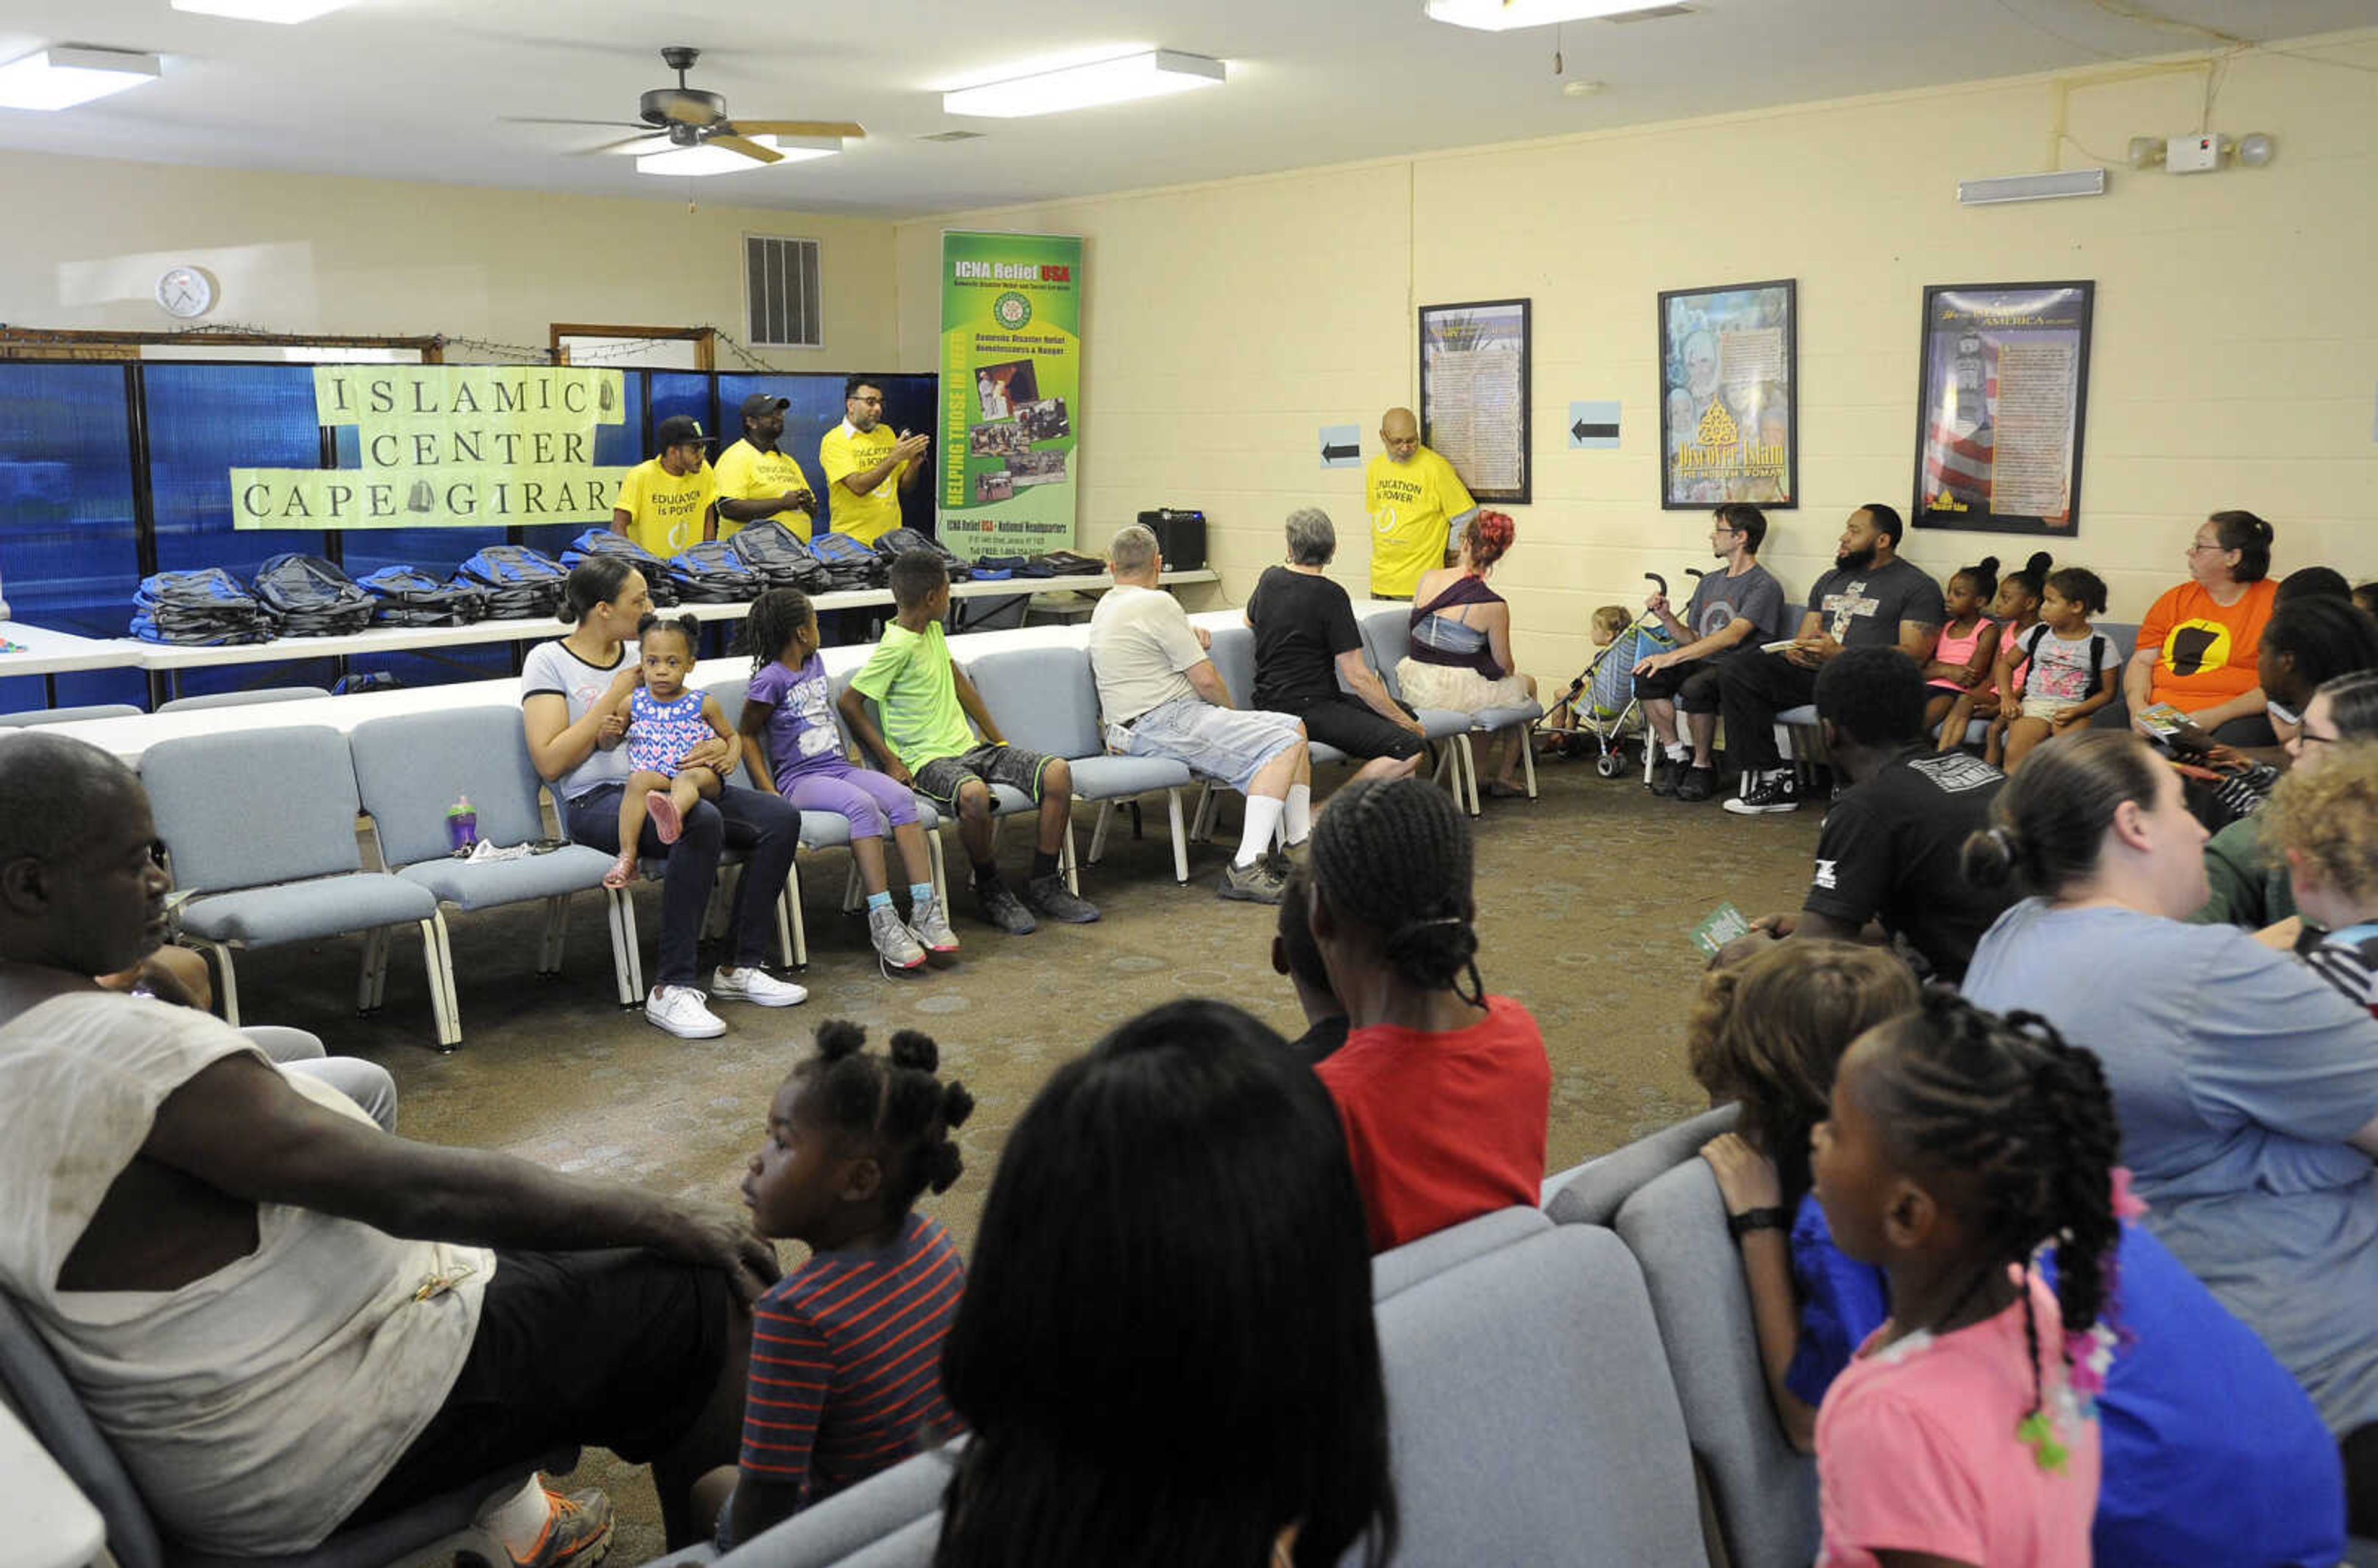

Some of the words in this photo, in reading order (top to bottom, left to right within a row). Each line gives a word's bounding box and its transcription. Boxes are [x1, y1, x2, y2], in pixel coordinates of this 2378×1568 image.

[955, 261, 991, 278] ICNA
[994, 263, 1038, 281] Relief
[1041, 263, 1071, 282] USA
[333, 379, 586, 412] ISLAMIC
[948, 392, 965, 440] THOSE
[371, 430, 586, 466] CENTER
[1743, 436, 1785, 465] Islam
[947, 443, 964, 505] HELPING
[243, 484, 395, 518] CAPE
[446, 480, 622, 514] GIRAR
